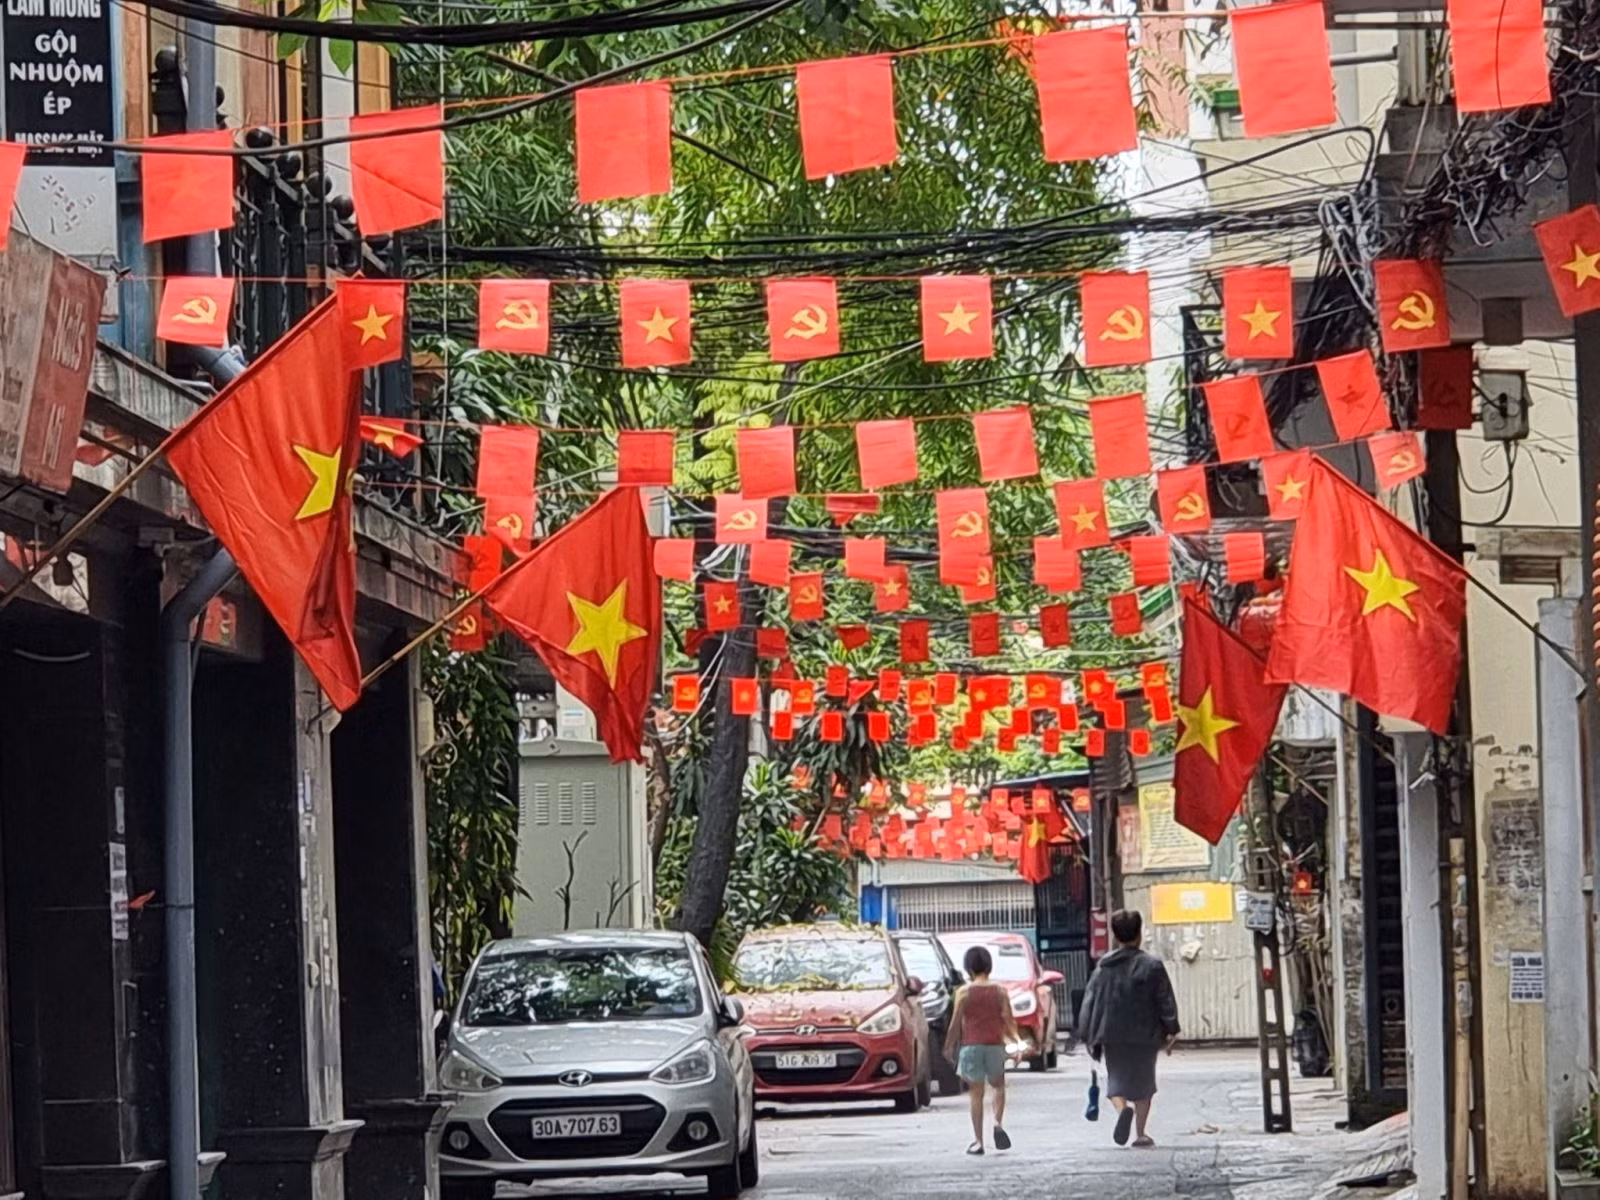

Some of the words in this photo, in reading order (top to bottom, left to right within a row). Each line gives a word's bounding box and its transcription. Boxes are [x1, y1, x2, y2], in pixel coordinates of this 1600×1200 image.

[34, 28, 77, 58] GỘI
[9, 58, 104, 87] NHUỘM
[43, 91, 72, 115] ÉP
